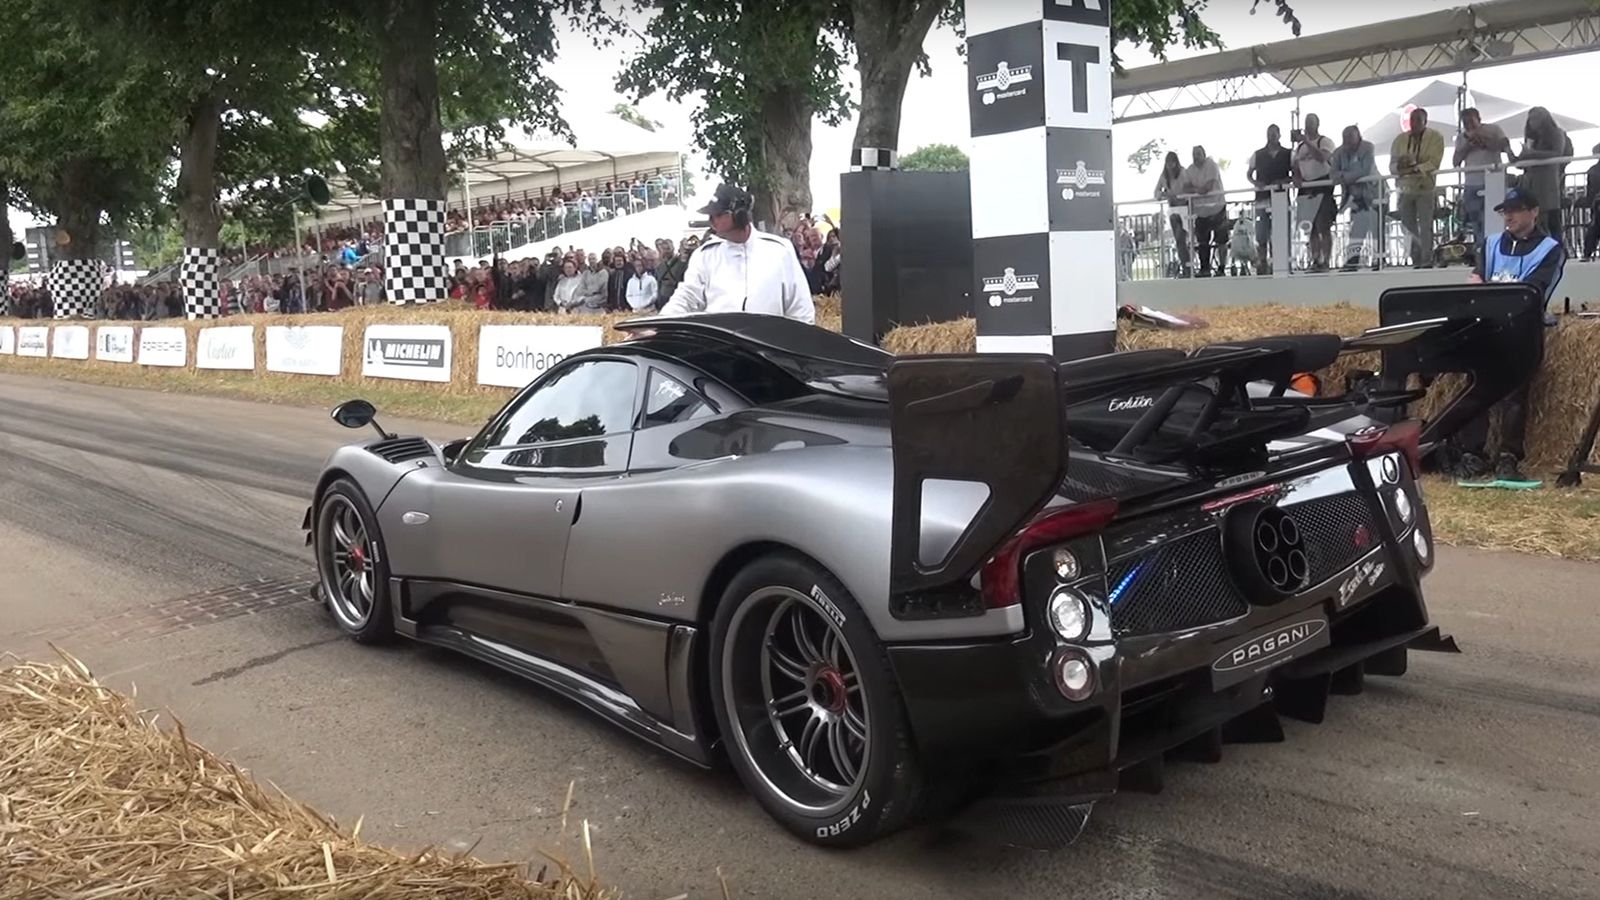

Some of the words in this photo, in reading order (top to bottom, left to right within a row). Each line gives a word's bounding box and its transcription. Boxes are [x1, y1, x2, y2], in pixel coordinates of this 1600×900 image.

[385, 343, 441, 360] MICHELIN
[496, 345, 573, 370] Bonham
[1108, 395, 1154, 412] Evolution
[811, 584, 846, 627] PIRELLI
[1232, 623, 1310, 664] PAGANI
[862, 789, 870, 809] P
[817, 806, 861, 838] ZERO
